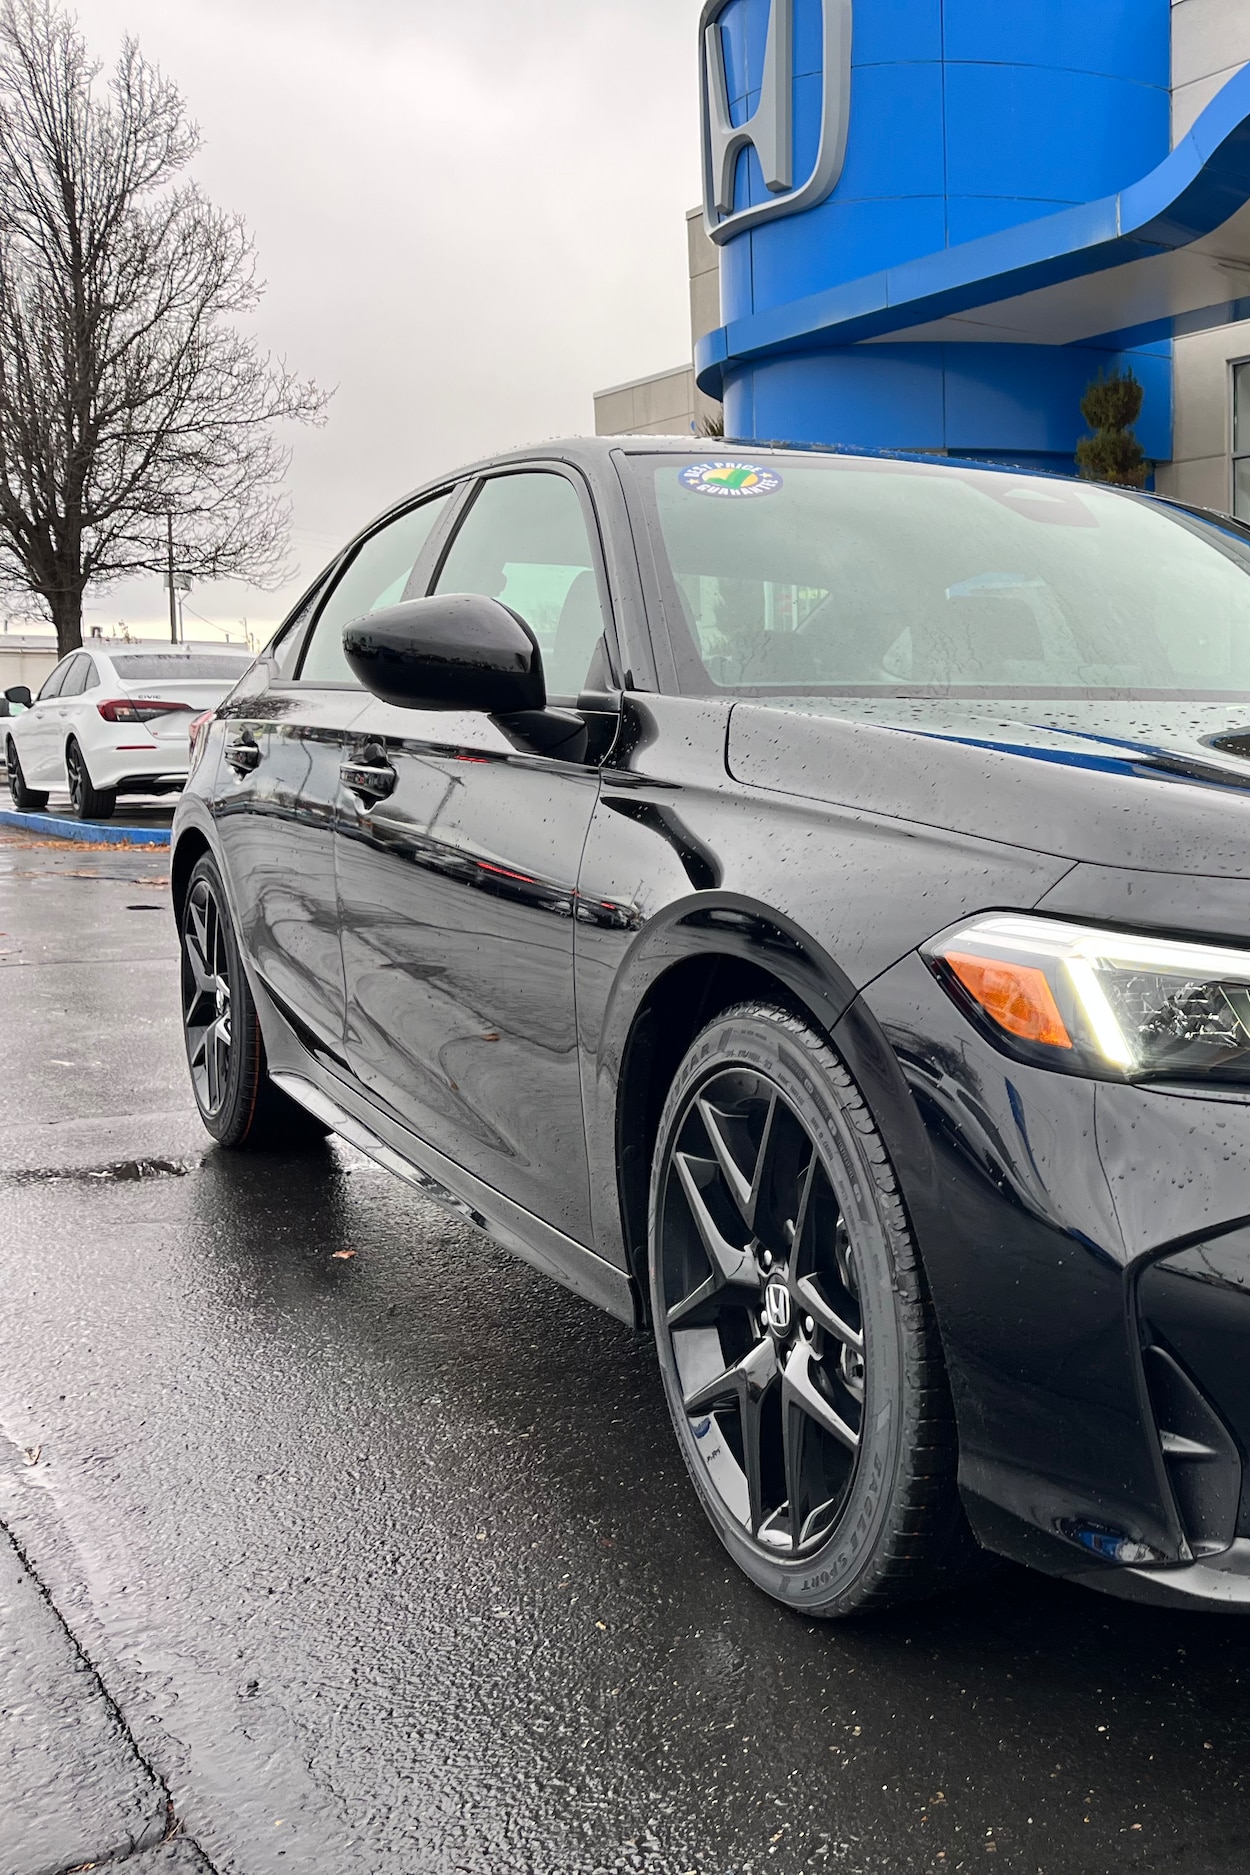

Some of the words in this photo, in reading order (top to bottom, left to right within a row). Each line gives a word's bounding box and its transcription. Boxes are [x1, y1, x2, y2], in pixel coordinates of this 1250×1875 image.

[684, 463, 709, 478] BEST
[714, 462, 763, 473] PRICE
[696, 479, 779, 496] GUARANTEE
[800, 1552, 849, 1592] SPORT
